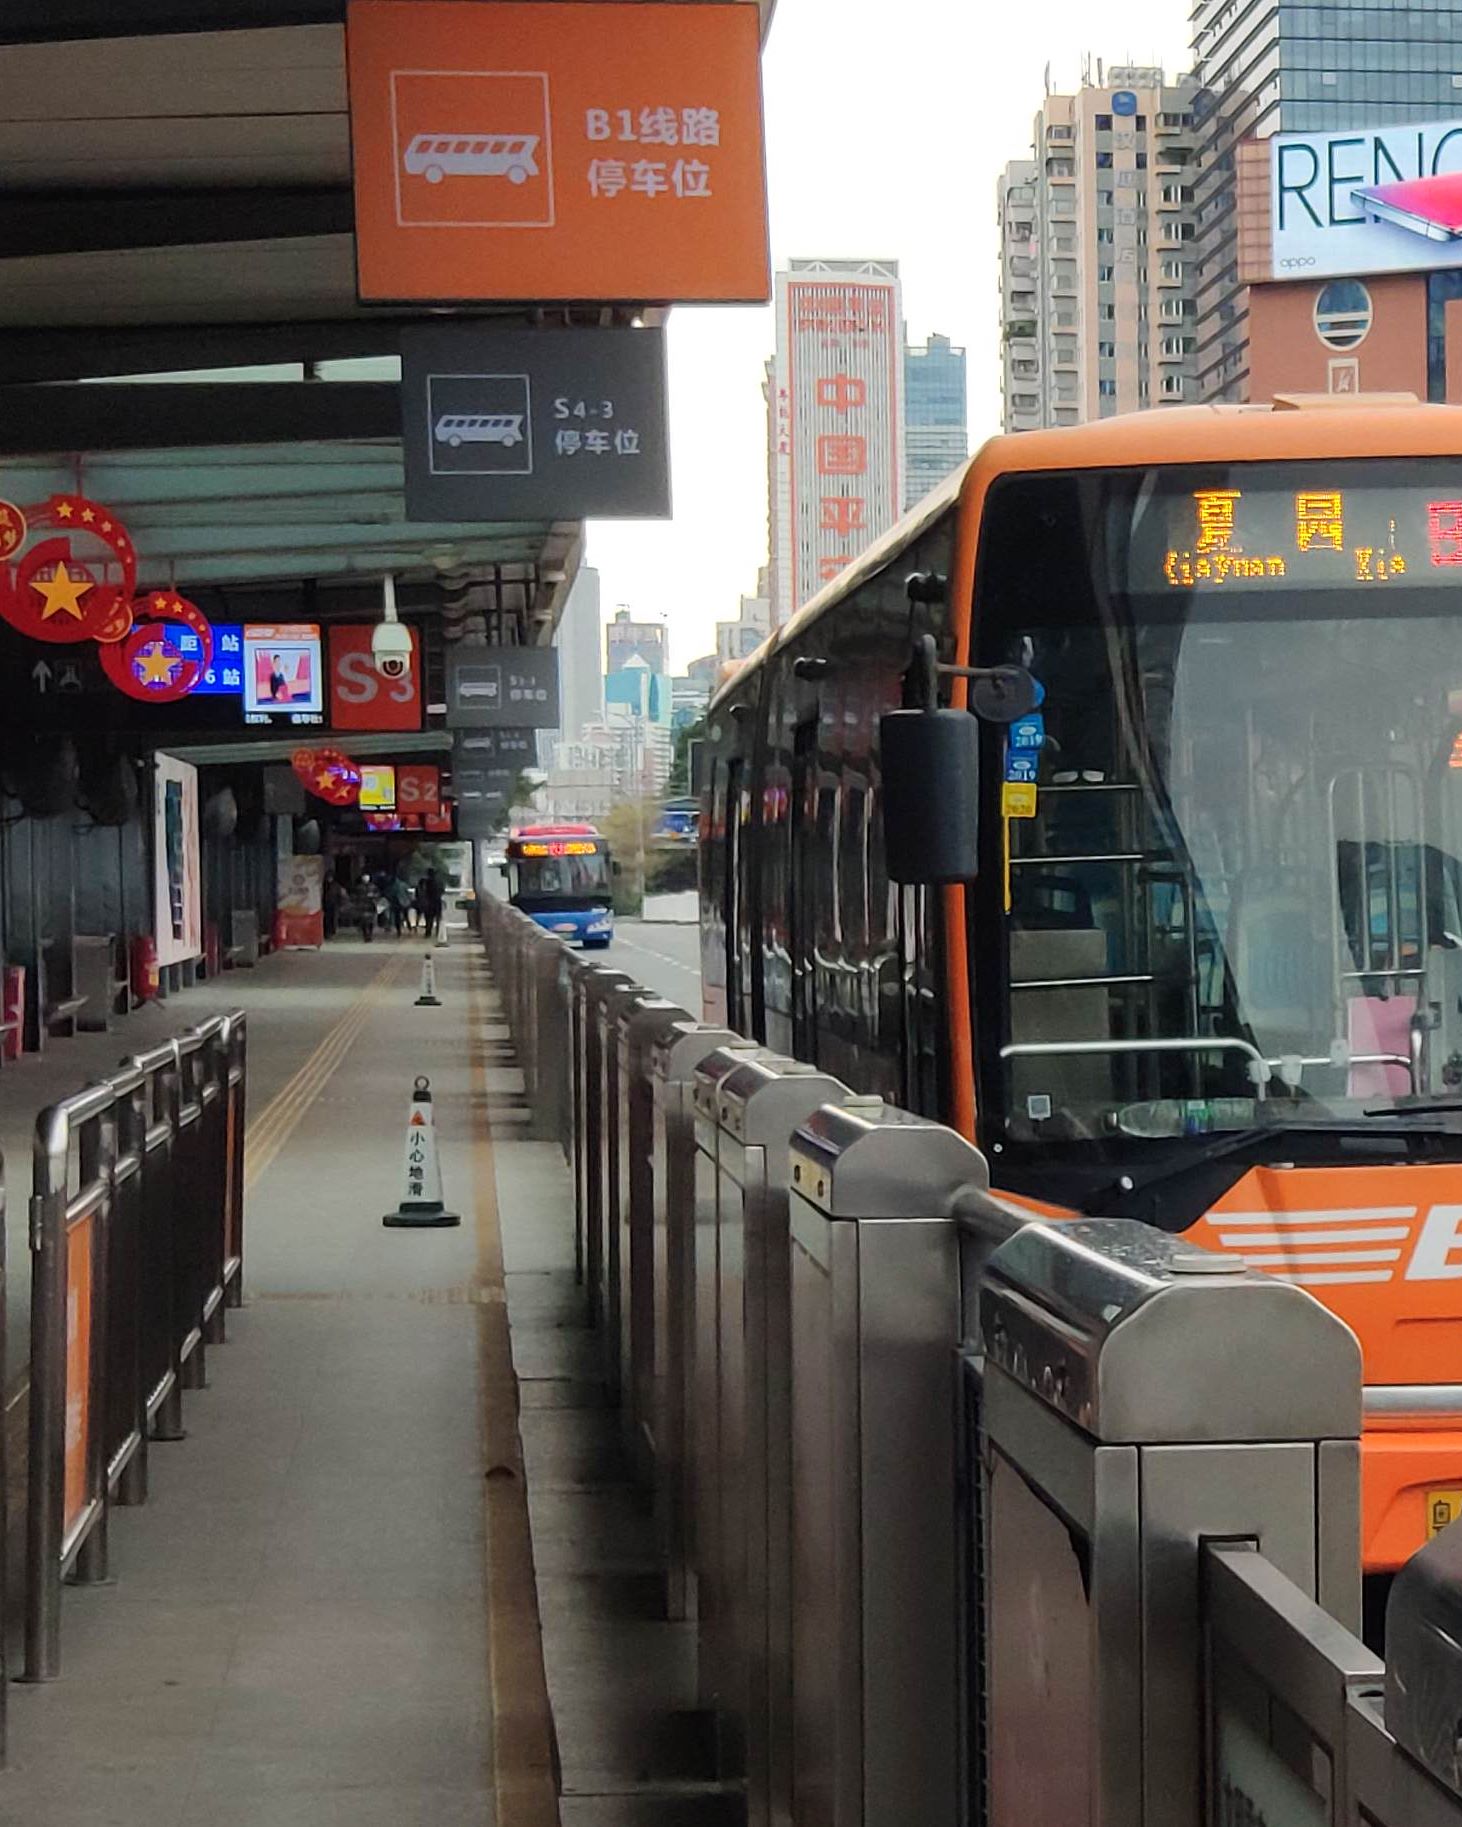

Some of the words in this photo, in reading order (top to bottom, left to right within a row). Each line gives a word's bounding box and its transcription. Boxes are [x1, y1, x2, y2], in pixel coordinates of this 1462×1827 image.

[586, 107, 720, 146] B1线路
[587, 159, 713, 198] 停车位
[554, 398, 614, 419] S4-3
[555, 429, 640, 455] 停车位
[337, 652, 415, 704] S3
[401, 777, 437, 802] S2
[408, 1130, 426, 1198] 小心地滑
